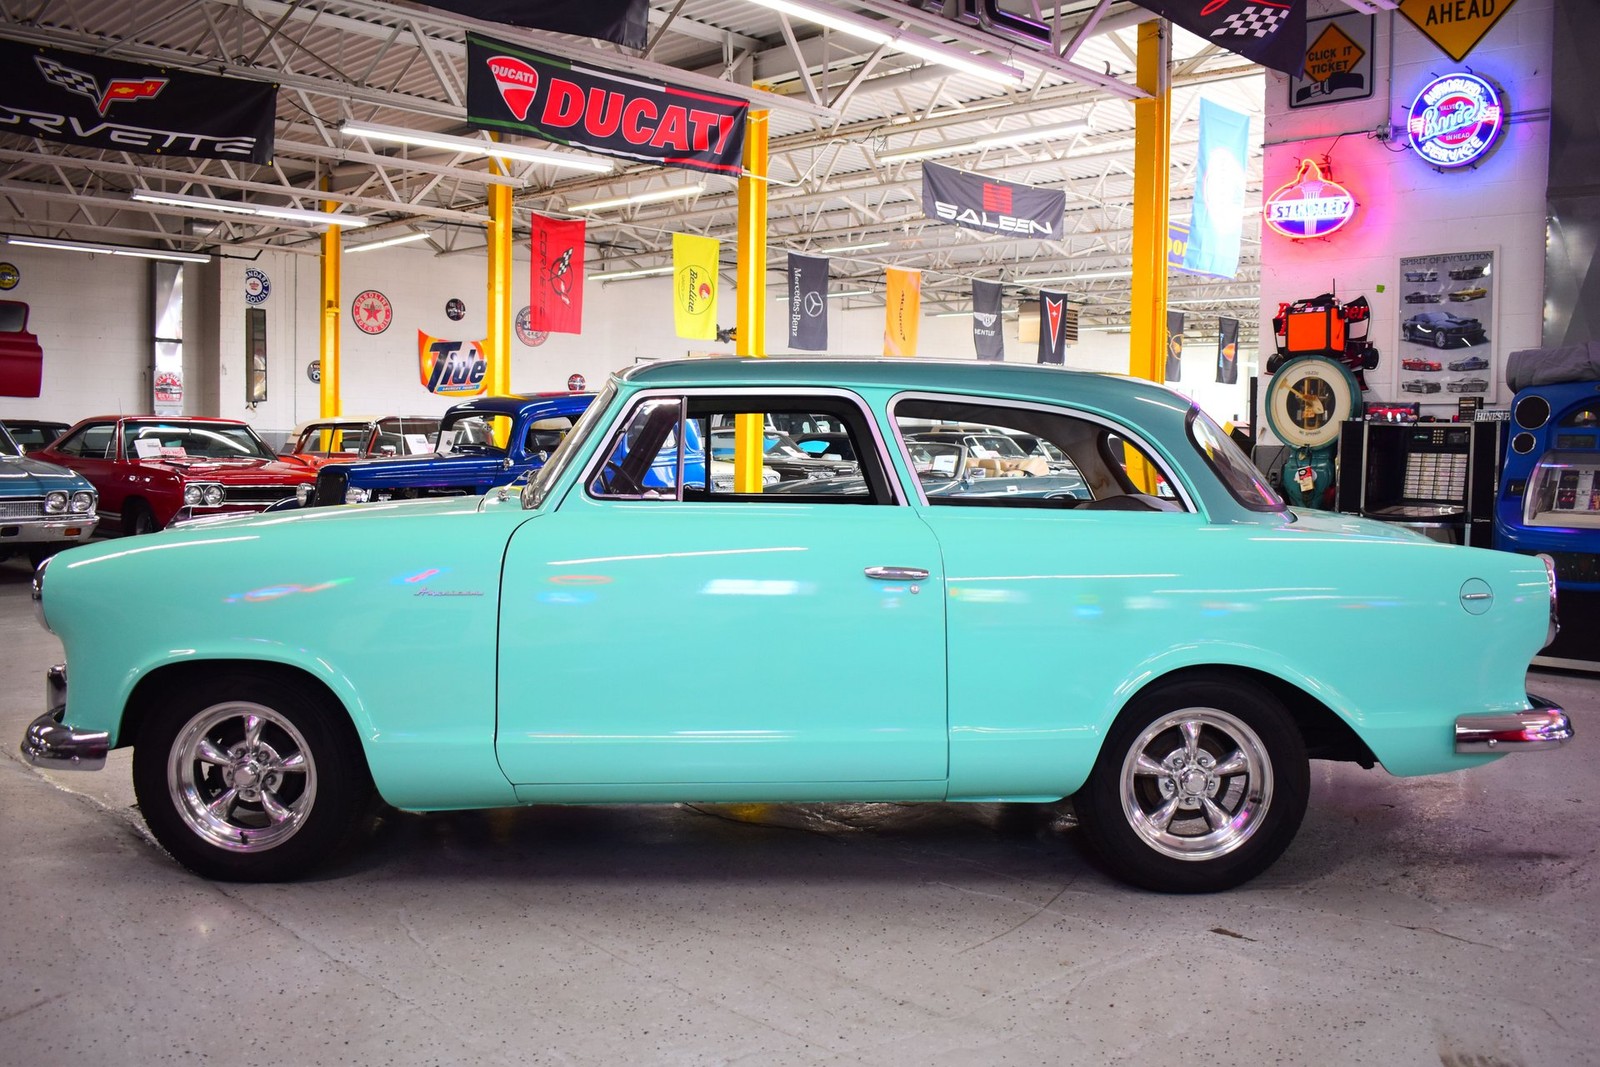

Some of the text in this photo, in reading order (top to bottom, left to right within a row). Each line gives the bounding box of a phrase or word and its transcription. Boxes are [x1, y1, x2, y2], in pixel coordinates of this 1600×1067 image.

[1425, 0, 1495, 26] AHEAD
[1308, 46, 1352, 62] CLICK IT
[1311, 60, 1349, 74] TICKET
[491, 63, 534, 84] DUCATI
[541, 78, 735, 155] DUCATI
[1422, 135, 1483, 161] SERVICE
[935, 201, 1053, 234] SALEEN
[1401, 252, 1493, 266] SPIRIT OF EVOLUTION
[540, 230, 548, 317] CORVETTE
[355, 292, 389, 307] GASOLINE
[688, 268, 698, 312] Beeline
[791, 267, 802, 337] Mercedes-Benz
[428, 341, 487, 393] Tide
[1477, 412, 1503, 421] HINES
